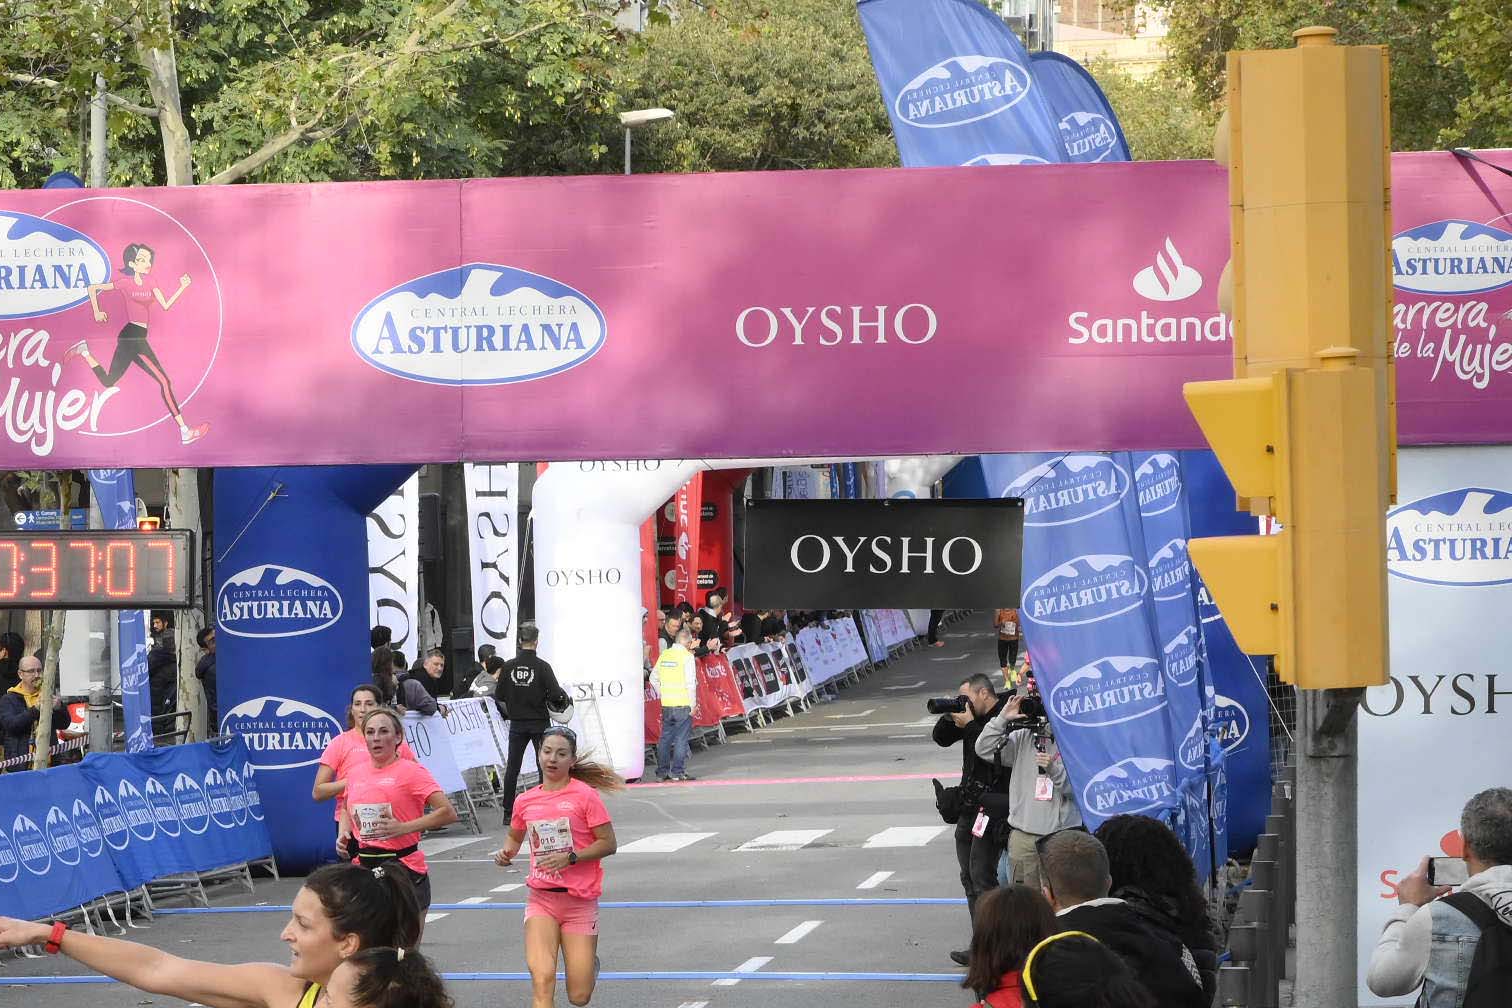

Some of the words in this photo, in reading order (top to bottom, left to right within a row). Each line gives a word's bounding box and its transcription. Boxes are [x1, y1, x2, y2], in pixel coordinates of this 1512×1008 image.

[13, 247, 85, 258] LECHERA
[411, 306, 489, 318] CENTRAL
[497, 305, 577, 317] LECHERA
[735, 303, 938, 348] OYSHO
[1392, 301, 1488, 331] arrera
[372, 311, 586, 355] ASTURIANA
[1417, 331, 1434, 358] la
[1430, 323, 1512, 390] Muje
[1414, 521, 1482, 532] CENTRAL
[790, 534, 983, 576] OYSHO
[546, 568, 621, 587] OYSHO
[221, 594, 333, 622] ASTURIANA
